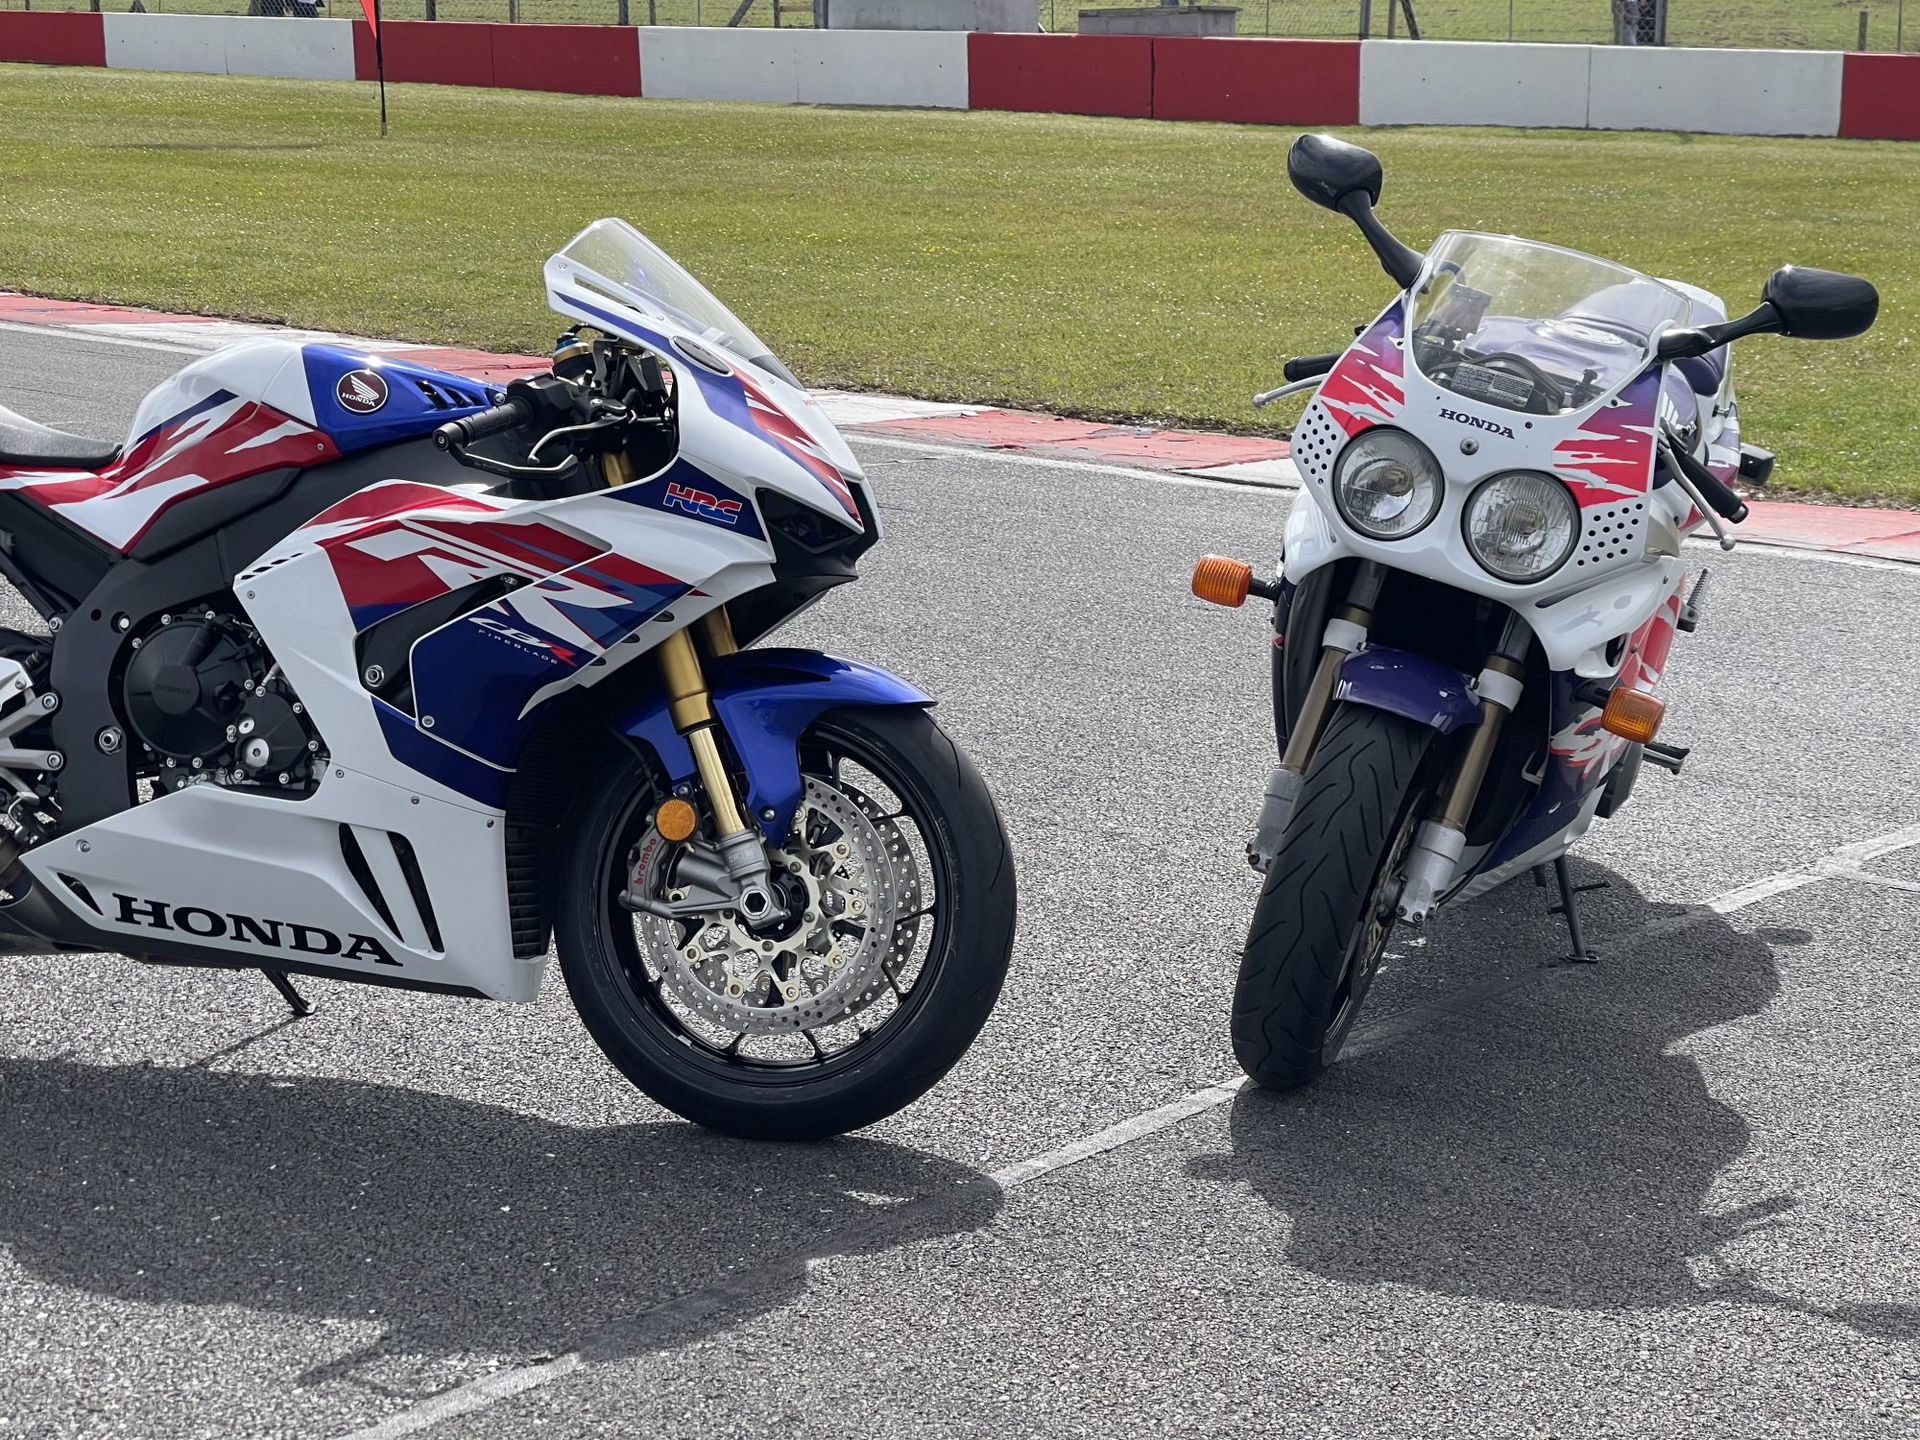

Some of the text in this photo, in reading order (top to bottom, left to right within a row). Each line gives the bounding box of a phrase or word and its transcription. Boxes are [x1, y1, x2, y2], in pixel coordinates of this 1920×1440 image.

[341, 392, 376, 407] HONDA
[1439, 408, 1515, 440] HONDA
[663, 482, 743, 525] HRC
[468, 617, 577, 668] CBR
[478, 629, 558, 665] FIREBLADE
[633, 838, 657, 885] brembo
[112, 892, 404, 968] HONDA
